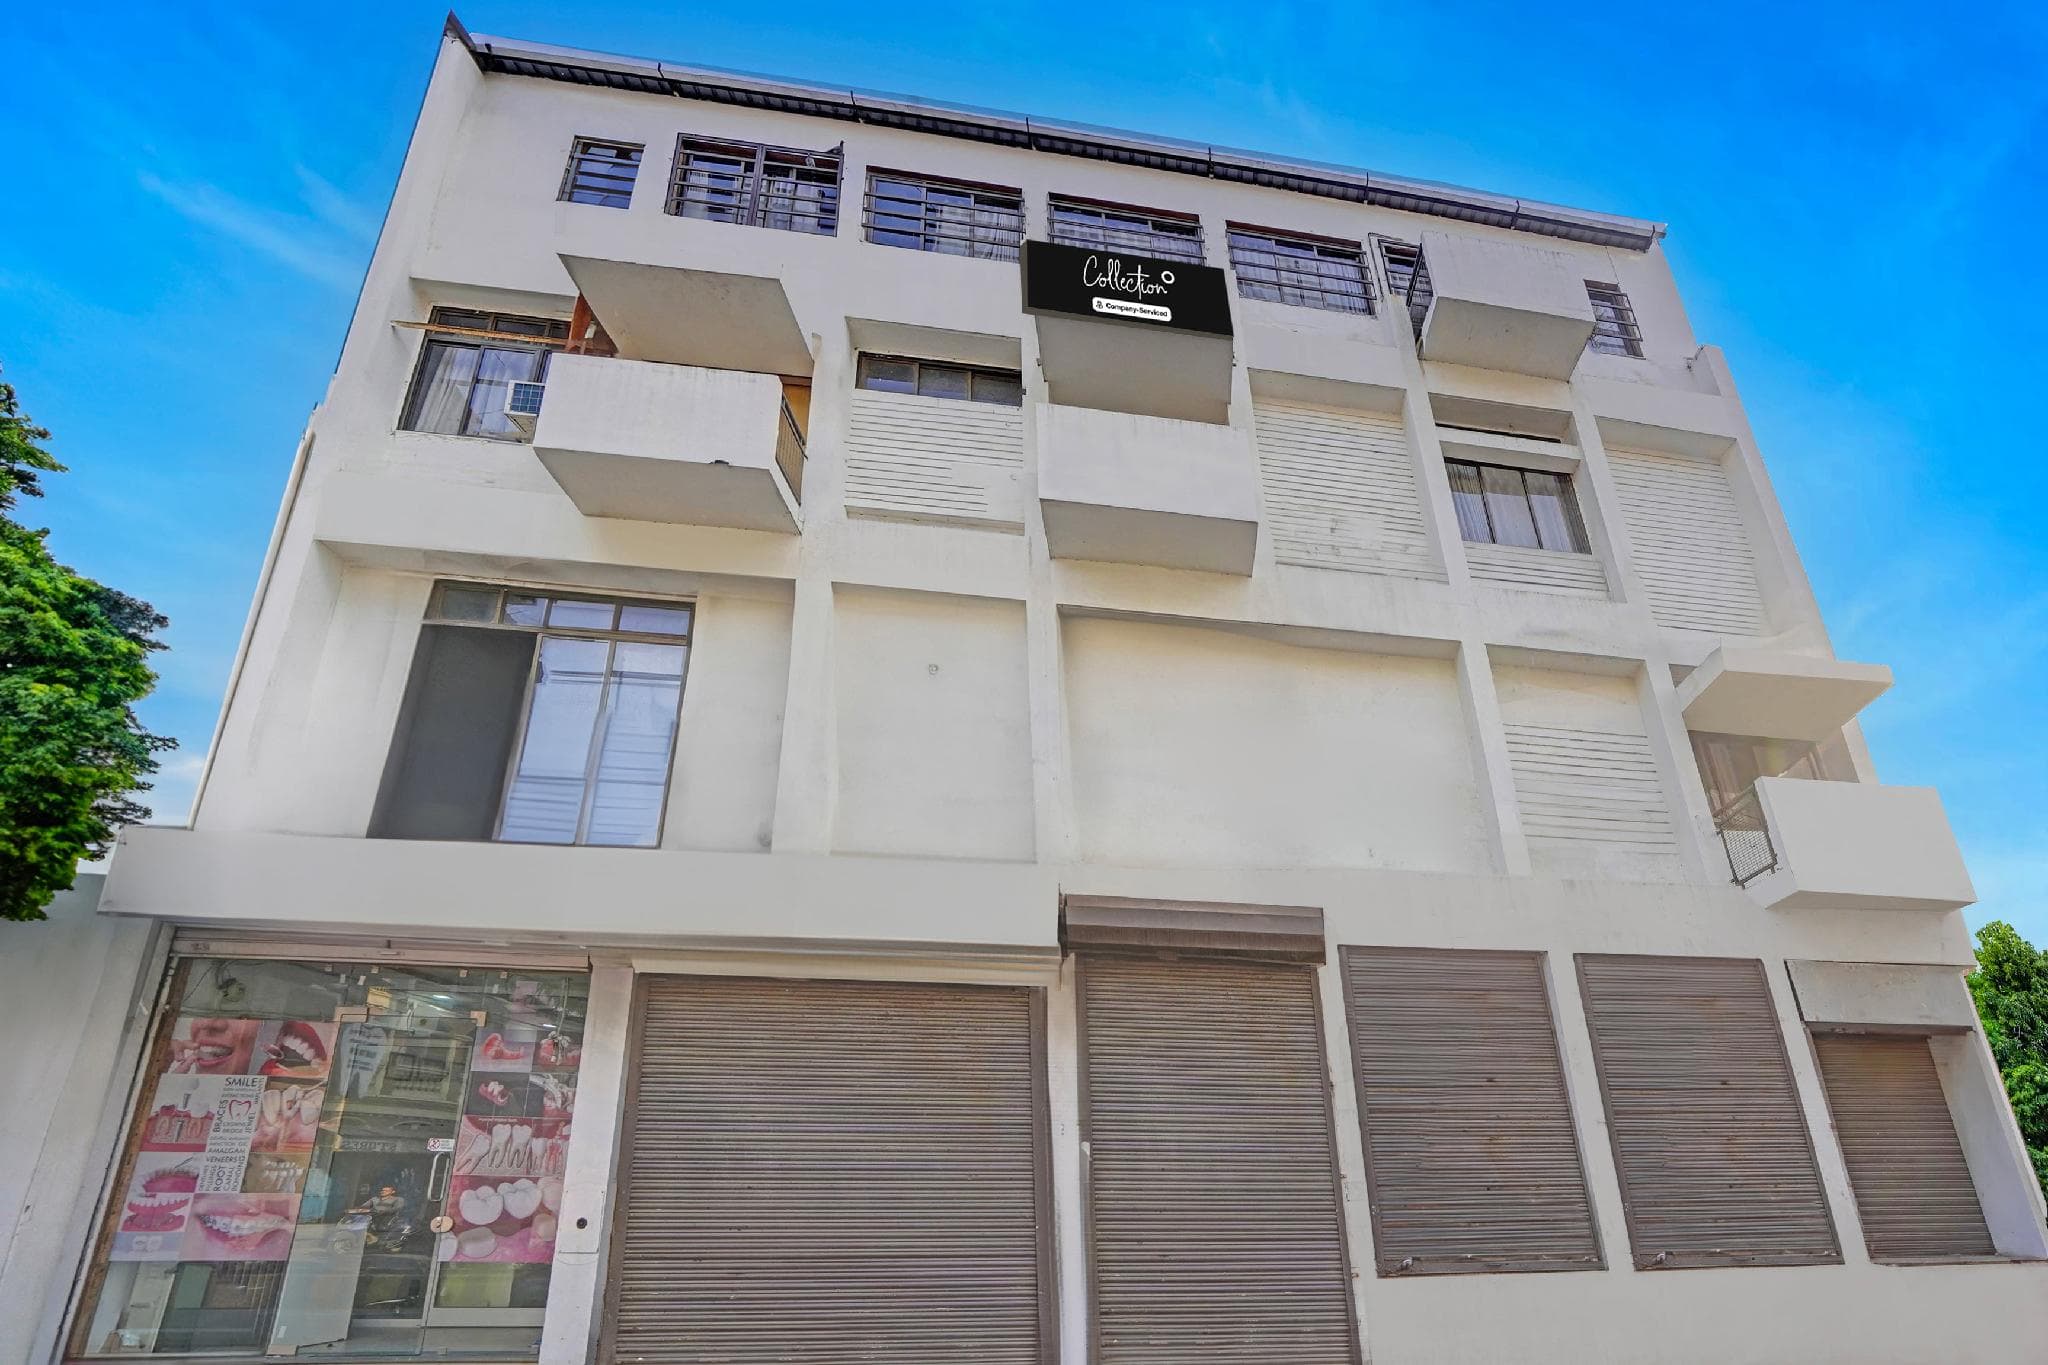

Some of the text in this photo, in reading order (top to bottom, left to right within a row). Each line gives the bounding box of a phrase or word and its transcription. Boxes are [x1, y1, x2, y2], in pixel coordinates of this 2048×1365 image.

[1083, 255, 1168, 300] Collection
[1106, 302, 1168, 317] Company-Serviced
[225, 1077, 258, 1087] SMILE
[213, 1099, 229, 1132] BRACES
[213, 1166, 227, 1191] ROOT
